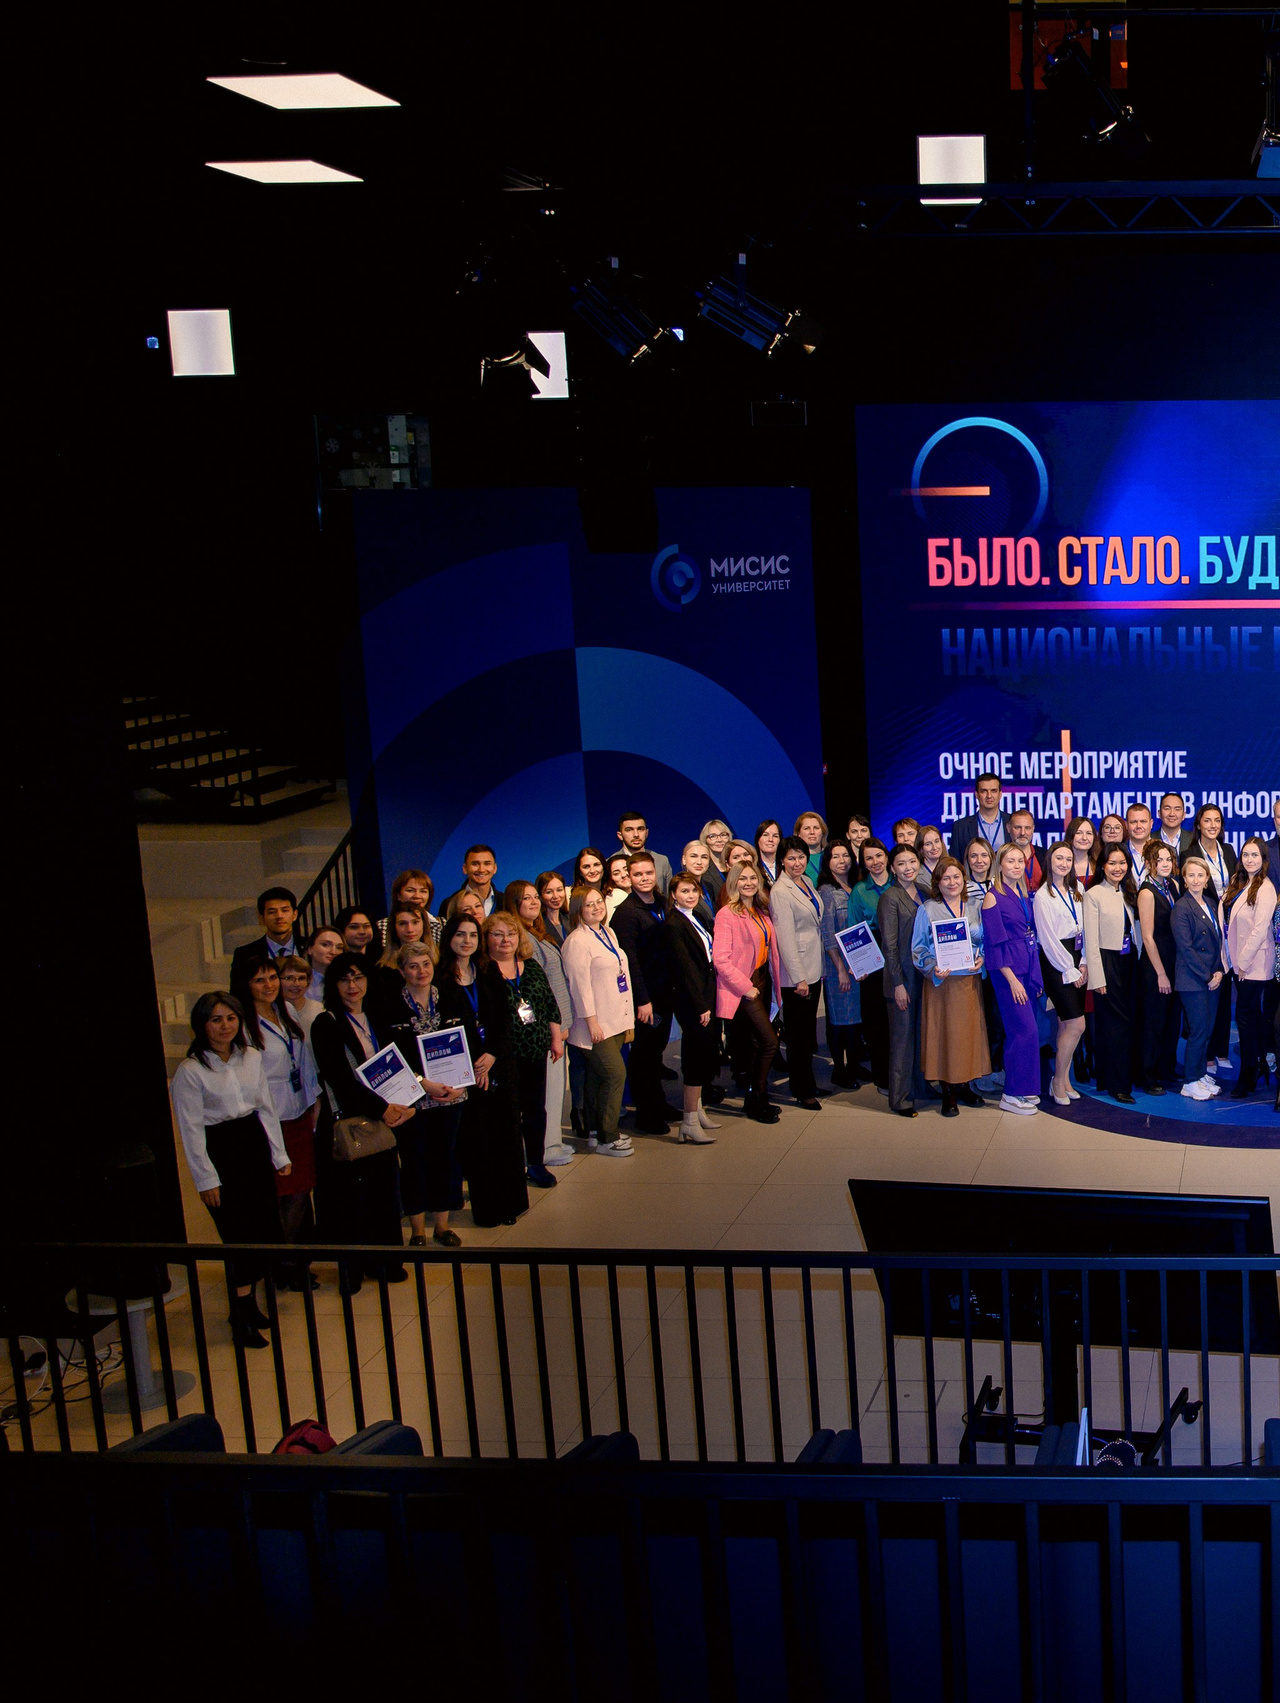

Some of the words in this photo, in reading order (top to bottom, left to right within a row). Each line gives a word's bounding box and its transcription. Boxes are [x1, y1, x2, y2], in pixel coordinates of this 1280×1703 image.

[710, 555, 790, 577] МИСИС
[928, 536, 1051, 586] БЫЛО.
[1058, 535, 1190, 586] СТАЛО.
[712, 579, 791, 594] УНИВЕРСИТЕТ
[939, 752, 1014, 779] ОЧНОЕ
[1020, 751, 1188, 779] МЕРОПРИЯТИЕ
[941, 792, 981, 823] ДЛ
[999, 790, 1196, 819] ДЕПАРТАМЕНТВ
[426, 1047, 452, 1060] ДИПЛОМ
